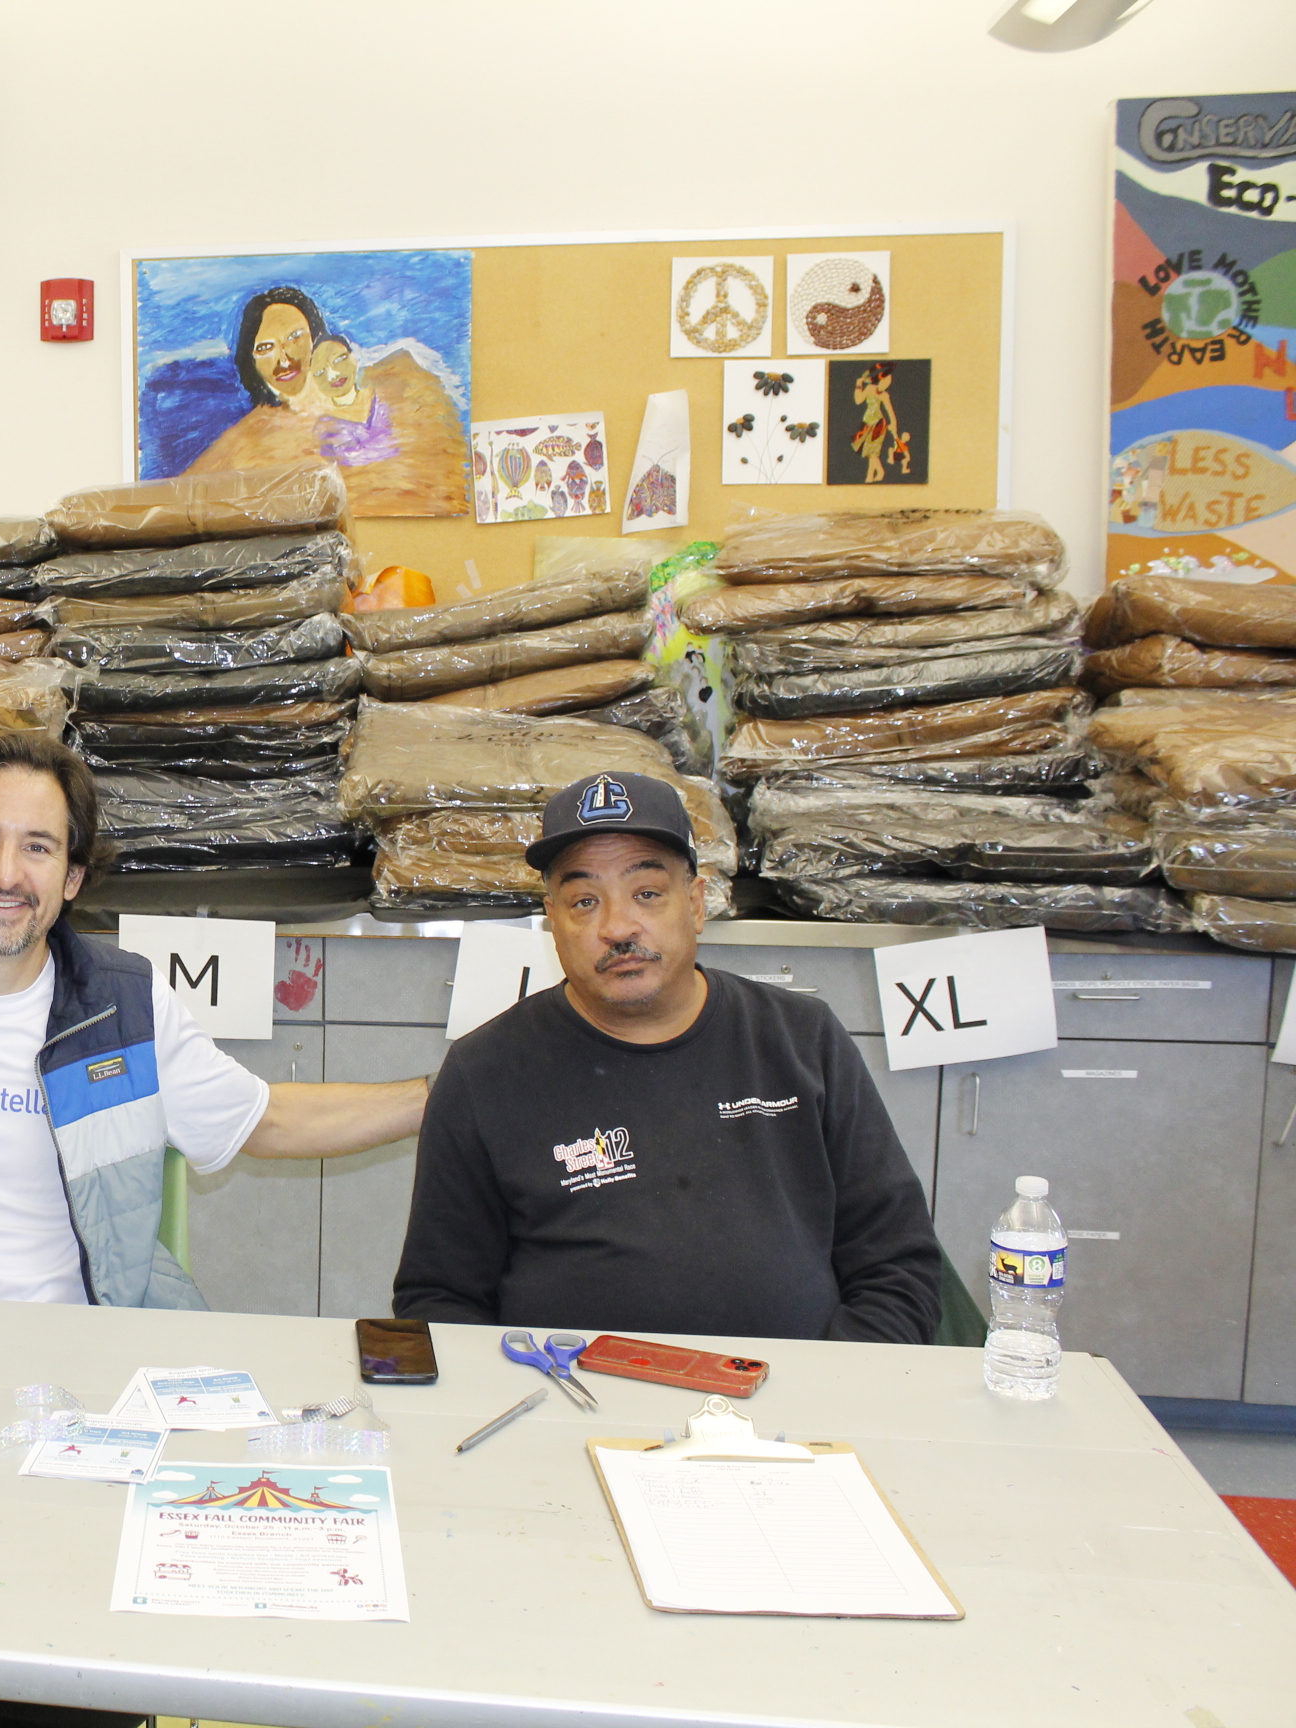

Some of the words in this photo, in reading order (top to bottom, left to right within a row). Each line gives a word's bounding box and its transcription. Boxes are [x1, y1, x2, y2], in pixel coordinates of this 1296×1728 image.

[1138, 249, 1204, 298] LOVE
[1212, 250, 1264, 347] MOTHER
[1142, 315, 1228, 367] EARTH
[1168, 438, 1252, 479] LESS
[1157, 491, 1267, 531] WASTE
[168, 952, 221, 1007] M
[894, 975, 988, 1037] XL
[92, 1068, 121, 1080] L.L.Bean
[731, 1097, 761, 1109] UNDER
[761, 1096, 798, 1108] ARMOUR
[552, 1138, 596, 1162] Charles
[565, 1152, 598, 1173] Street
[603, 1126, 635, 1162] 12
[560, 1174, 585, 1187] Maryland's
[596, 1165, 624, 1177] Monumental
[624, 1163, 636, 1171] Race
[159, 1512, 200, 1521] ESSEX
[204, 1514, 235, 1522] FALL
[239, 1515, 327, 1525] COMMUNITY
[333, 1518, 366, 1526] FAIR
